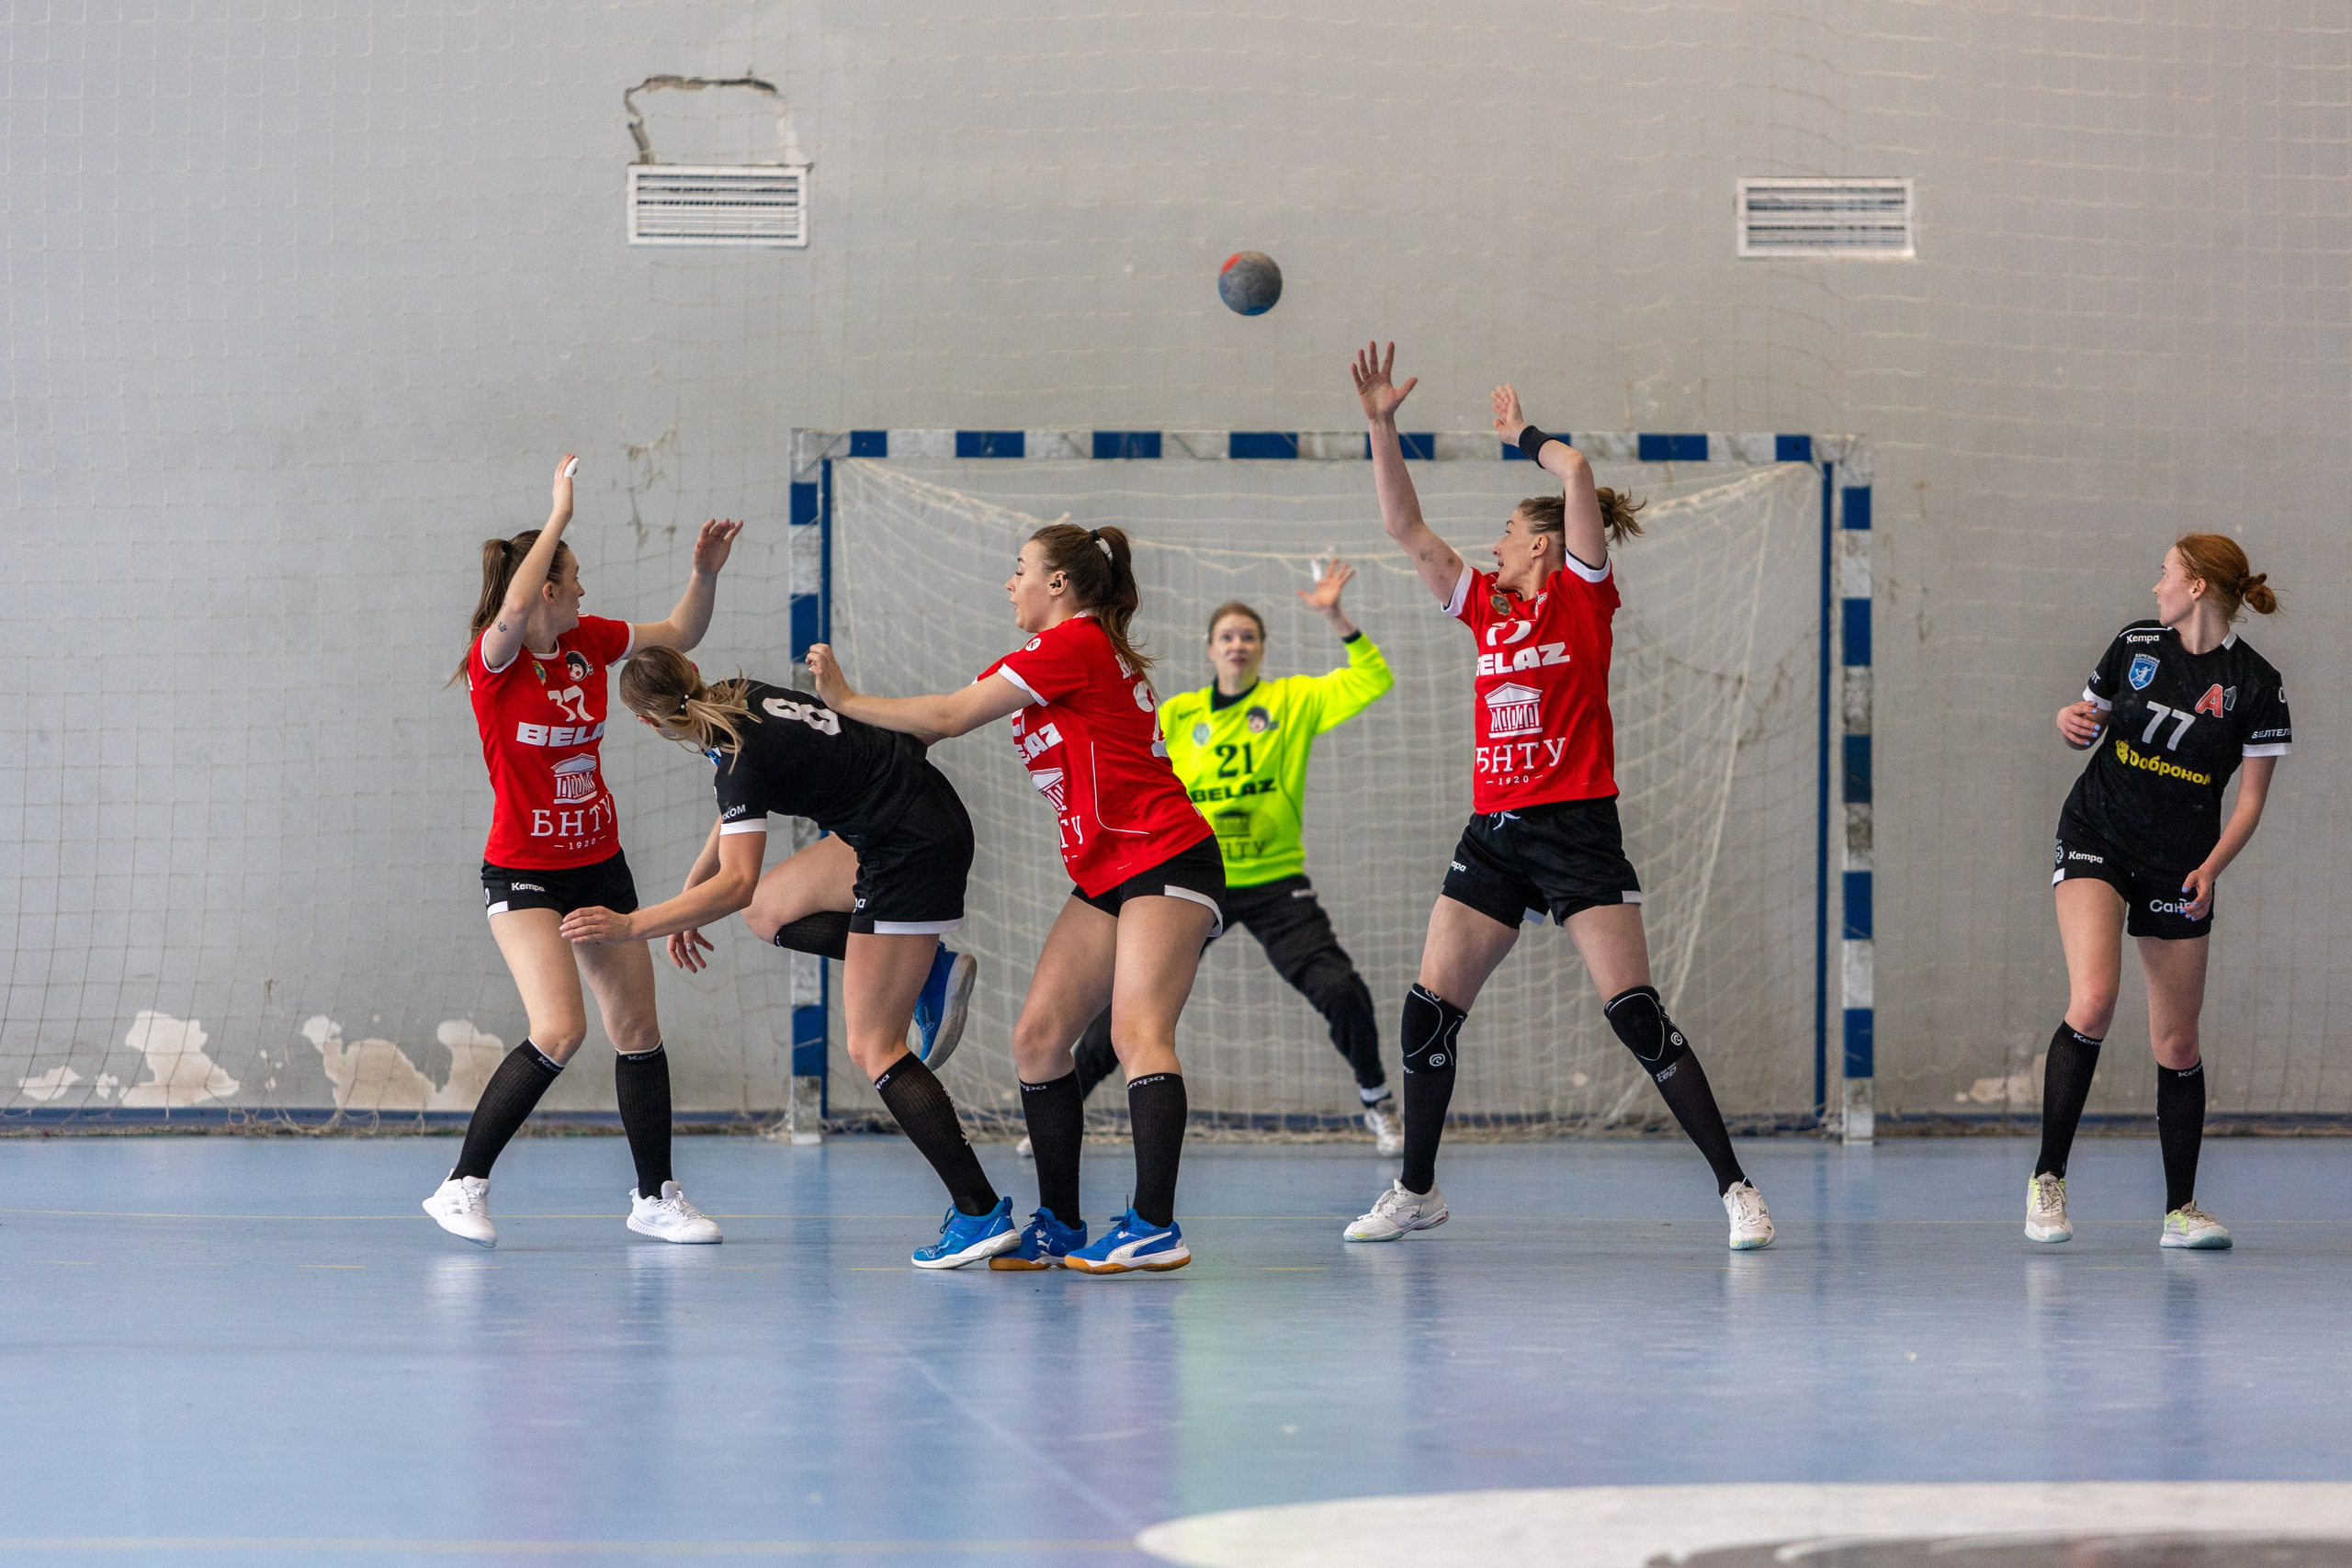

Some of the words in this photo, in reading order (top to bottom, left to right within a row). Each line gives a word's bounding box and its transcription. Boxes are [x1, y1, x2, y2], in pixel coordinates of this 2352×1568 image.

[2126, 634, 2160, 644] Kempa
[2194, 683, 2237, 719] A1
[516, 721, 606, 748] BELA
[2141, 700, 2197, 751] 77
[1216, 741, 1253, 779] 21
[1189, 778, 1277, 804] BELAZ
[530, 794, 612, 837] БНТУ
[2068, 851, 2104, 864] Kempa
[511, 882, 546, 892] Kempa
